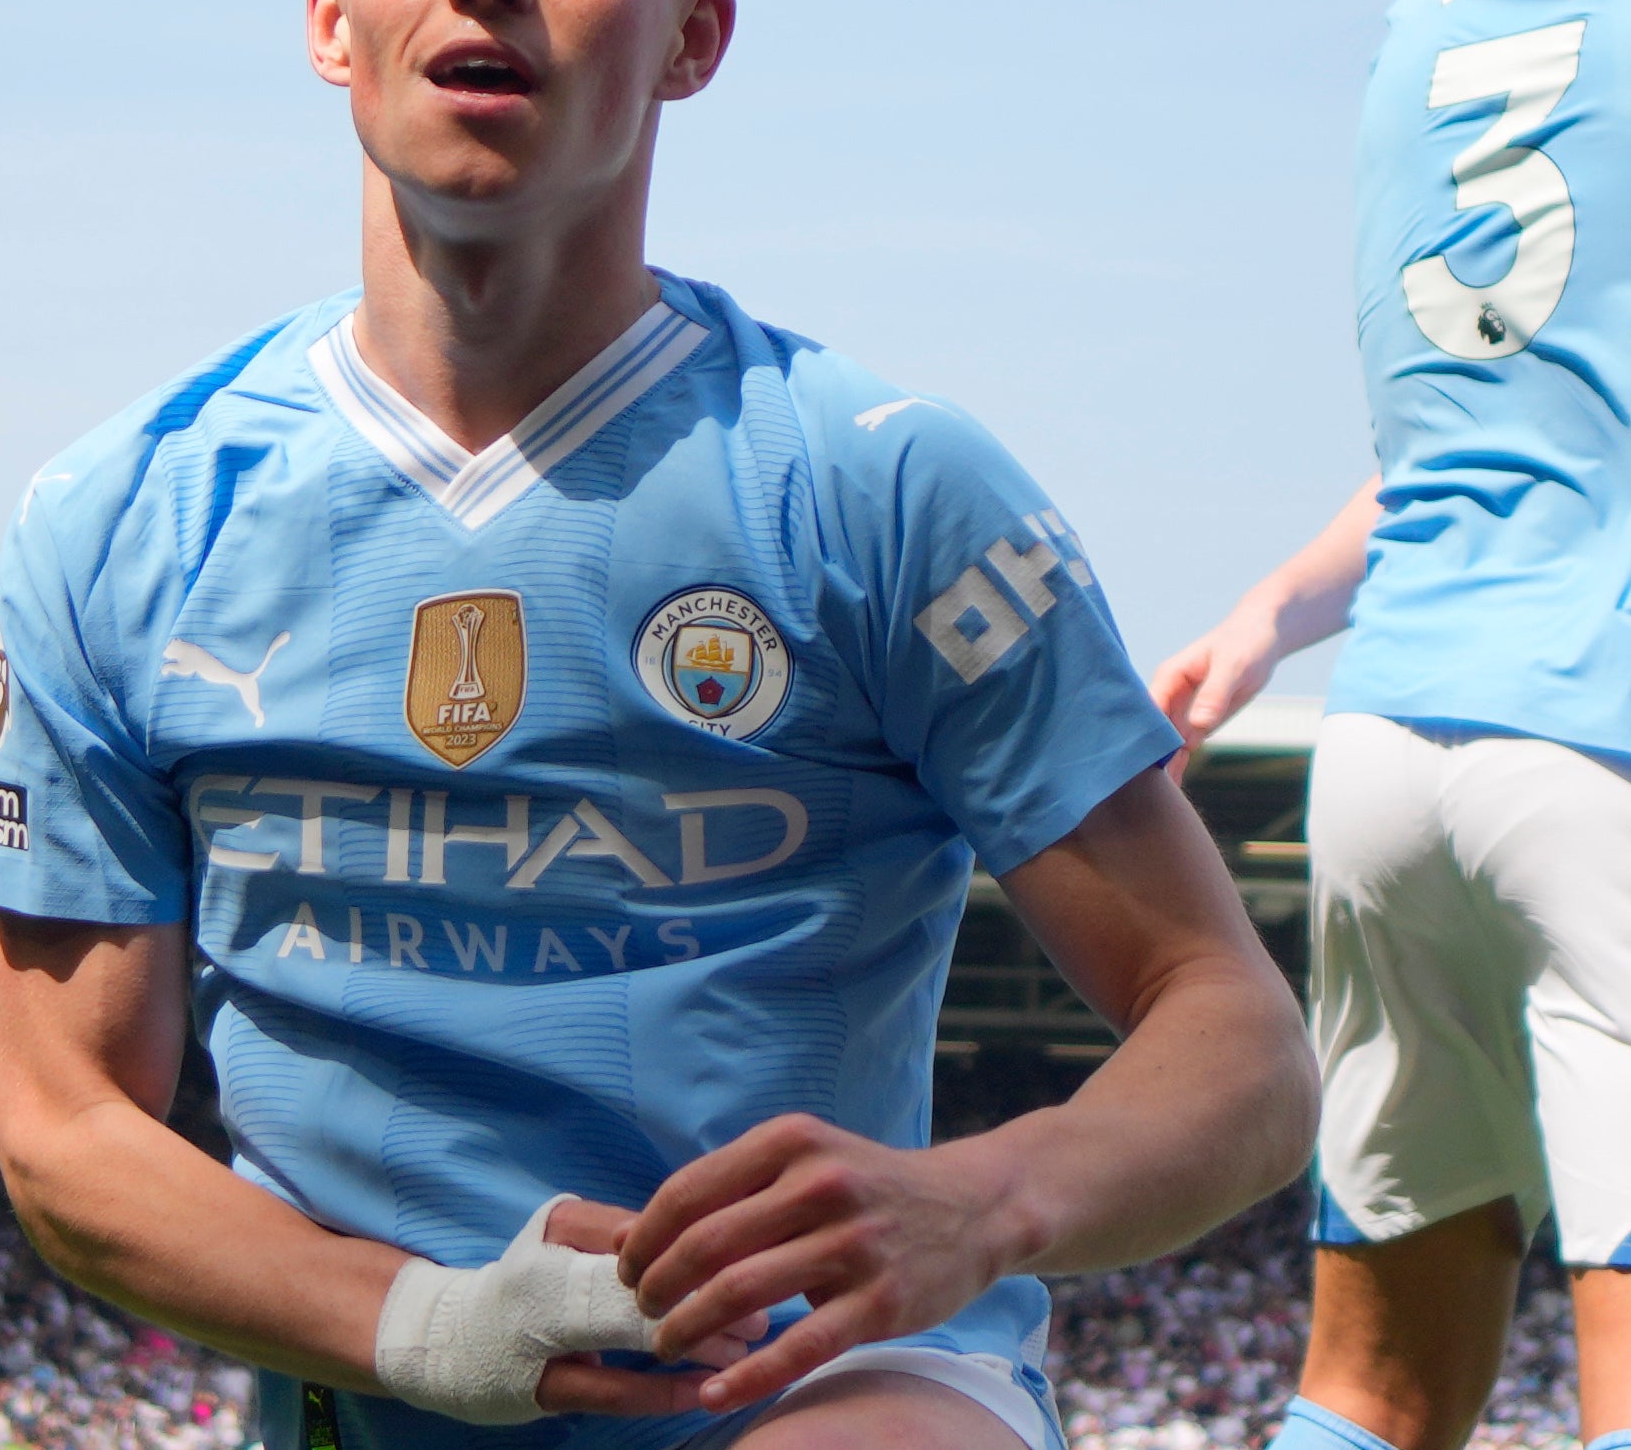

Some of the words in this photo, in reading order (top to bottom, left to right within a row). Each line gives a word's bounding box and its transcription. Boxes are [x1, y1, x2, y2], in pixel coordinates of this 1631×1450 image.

[1401, 17, 1588, 361] 3
[652, 597, 778, 652] MANCHESTER
[437, 701, 493, 725] FIFA
[445, 733, 478, 748] 2023
[189, 773, 810, 889] ETIHAD
[276, 901, 701, 973] AIRWAYS
